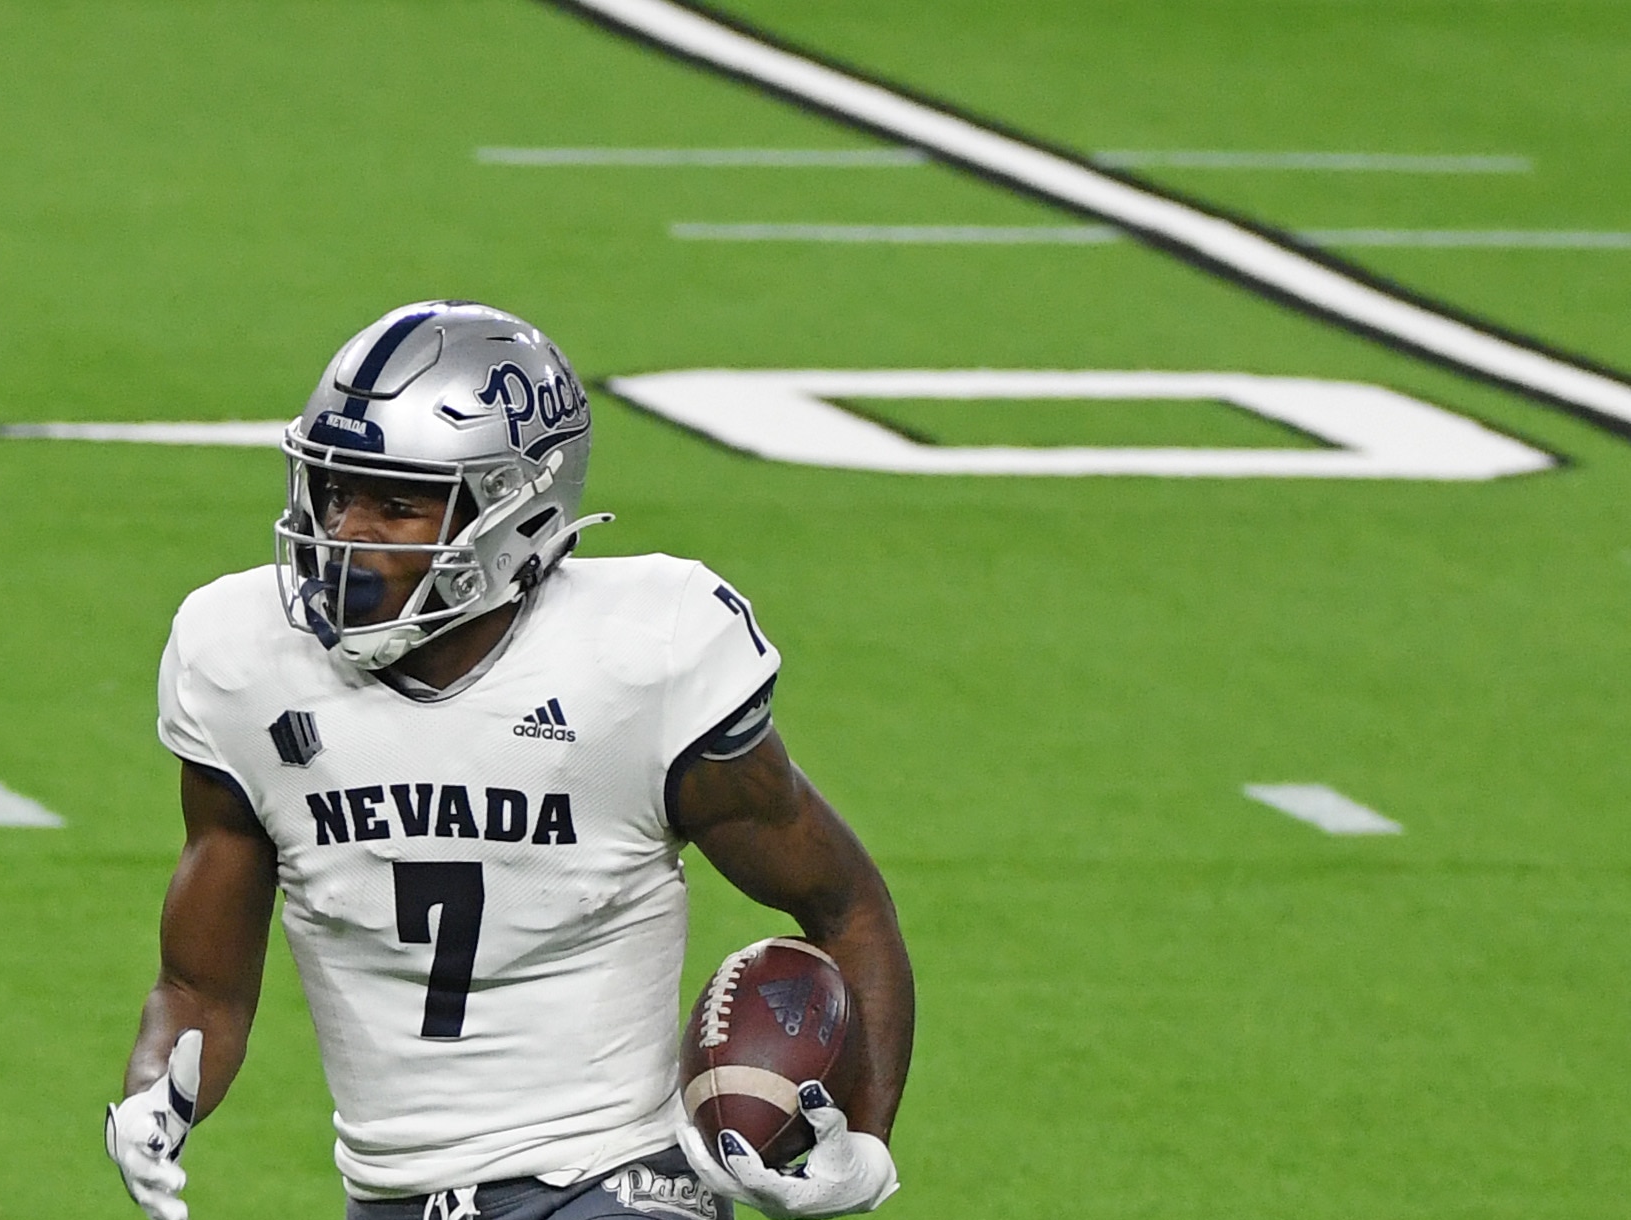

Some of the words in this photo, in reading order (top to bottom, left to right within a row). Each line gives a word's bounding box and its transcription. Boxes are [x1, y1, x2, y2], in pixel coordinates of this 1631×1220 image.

[713, 584, 767, 658] 7
[513, 722, 577, 743] adidas
[305, 783, 578, 846] NEVADA
[392, 861, 486, 1038] 7
